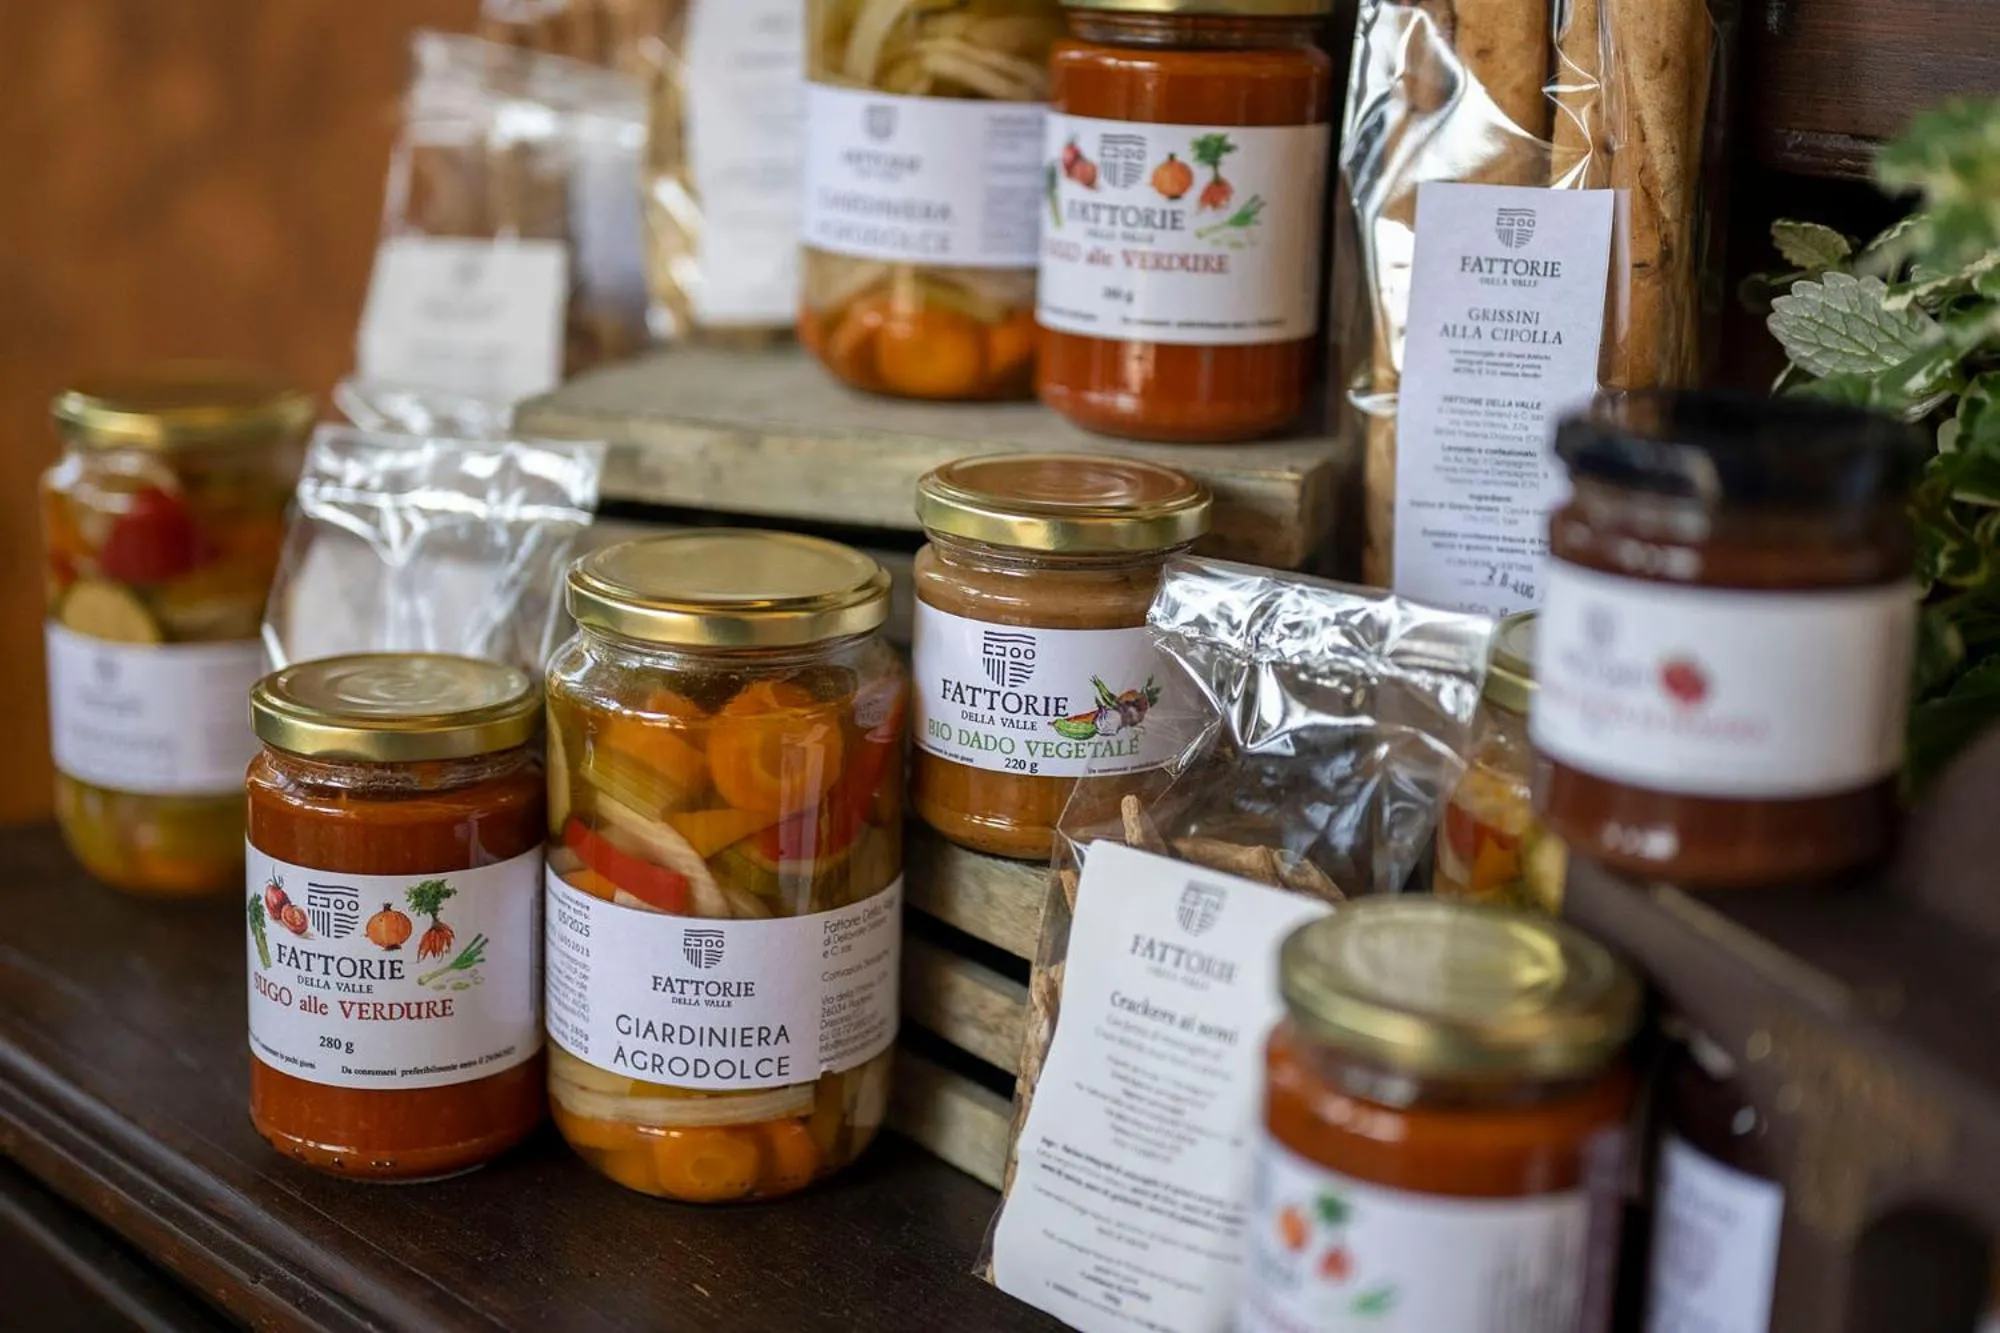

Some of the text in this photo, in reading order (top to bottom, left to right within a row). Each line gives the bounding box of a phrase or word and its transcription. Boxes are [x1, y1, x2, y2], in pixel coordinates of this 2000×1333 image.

[1121, 248, 1230, 274] VERDURE
[1460, 256, 1562, 278] FATTORIE
[1468, 307, 1540, 325] GRISSINI
[1440, 324, 1563, 345] ALLA CIPOLLA
[941, 678, 1069, 717] FATTORIE
[961, 710, 1037, 731] DELLA VALLE
[928, 718, 952, 741] BIO
[957, 729, 1016, 755] DADO
[1025, 736, 1140, 759] VEGETALE
[1004, 757, 1039, 774] 220 g
[277, 943, 405, 981] FATTORIE
[297, 974, 374, 995] DELLA VALLE
[652, 975, 756, 998] FATTORIE
[254, 971, 455, 1021] SUGO alle VERDURE
[672, 996, 733, 1009] DELLA VALLE
[616, 1013, 791, 1048] GIARDINIERA
[319, 1035, 355, 1054] 280 g
[341, 1065, 352, 1075] Da
[354, 1067, 397, 1077] consumarsi
[614, 1045, 790, 1080] AGRODOLCE
